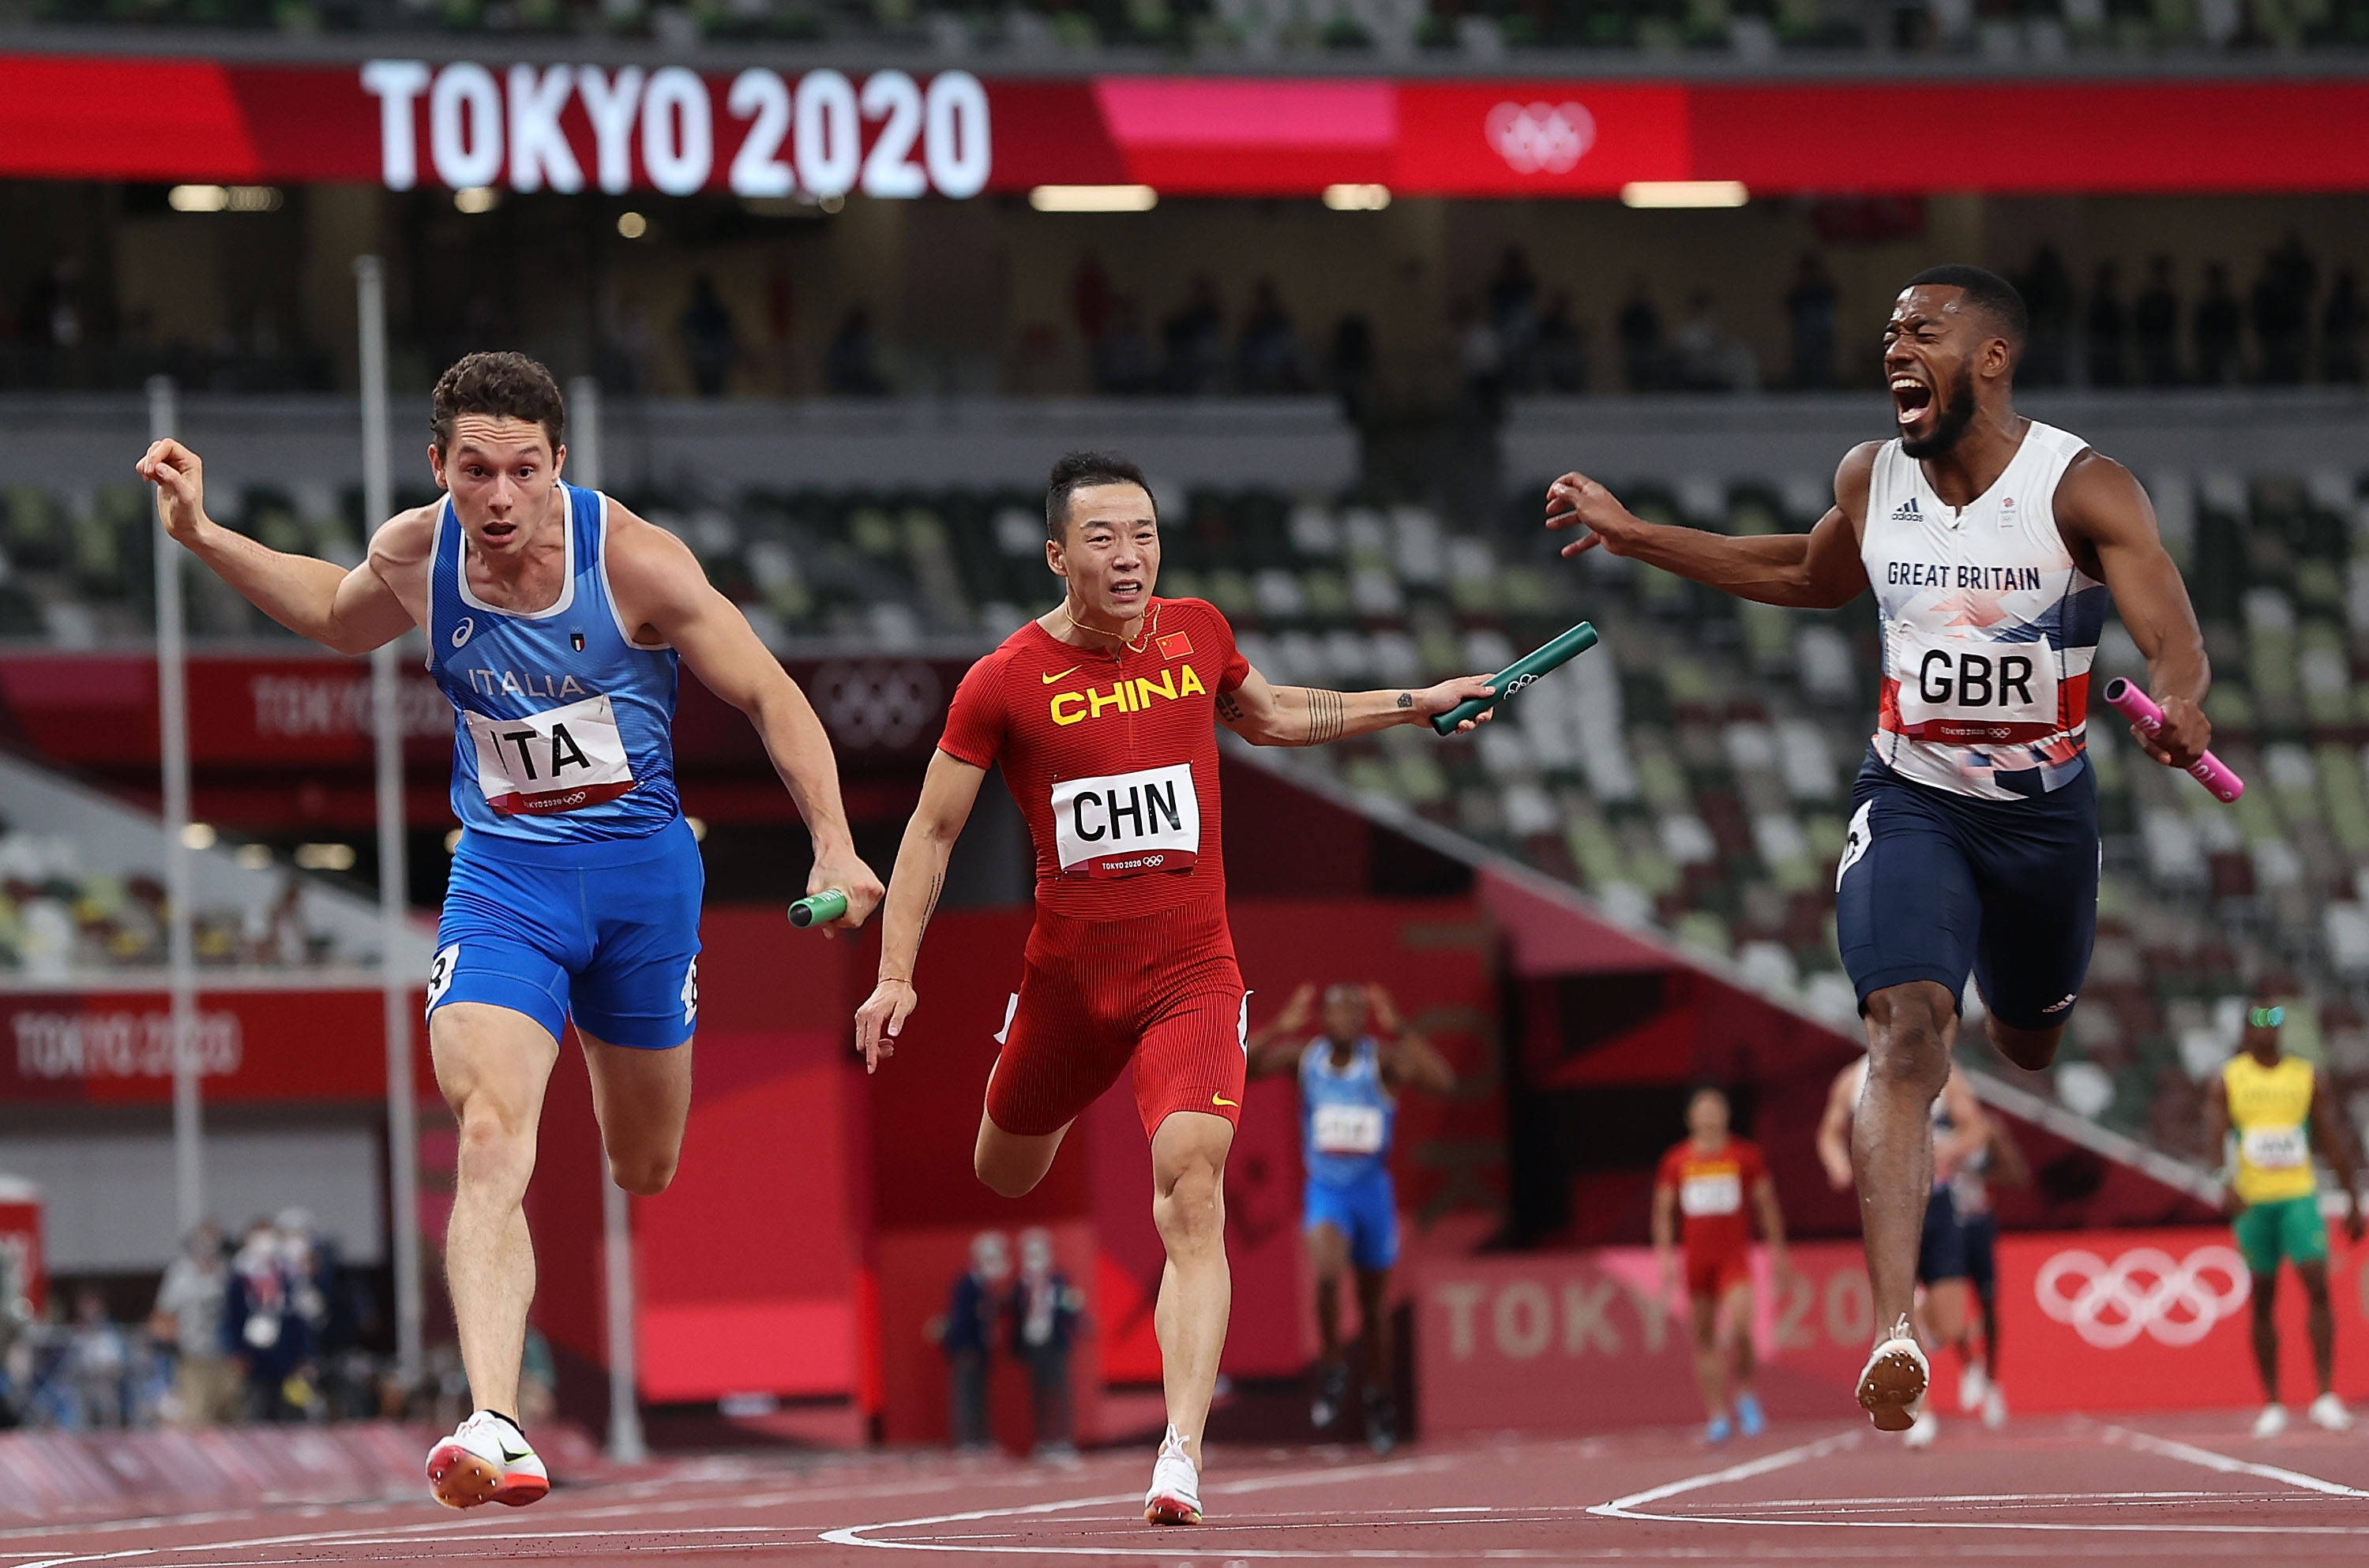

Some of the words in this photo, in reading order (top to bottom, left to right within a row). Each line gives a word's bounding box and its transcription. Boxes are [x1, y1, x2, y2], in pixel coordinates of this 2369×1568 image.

[362, 59, 713, 197] TOKYO
[728, 68, 993, 199] 2020
[1891, 512, 1924, 522] adidas
[1888, 561, 1950, 588] GREAT
[1958, 565, 2041, 590] BRITAIN
[468, 669, 586, 698] ITALIA
[1049, 665, 1207, 726] CHINA
[1919, 649, 2033, 707] GBR
[490, 722, 591, 780] ITA
[1072, 780, 1182, 842] CHN
[1124, 860, 1142, 868] 2020
[1437, 1279, 1672, 1358] TOKY
